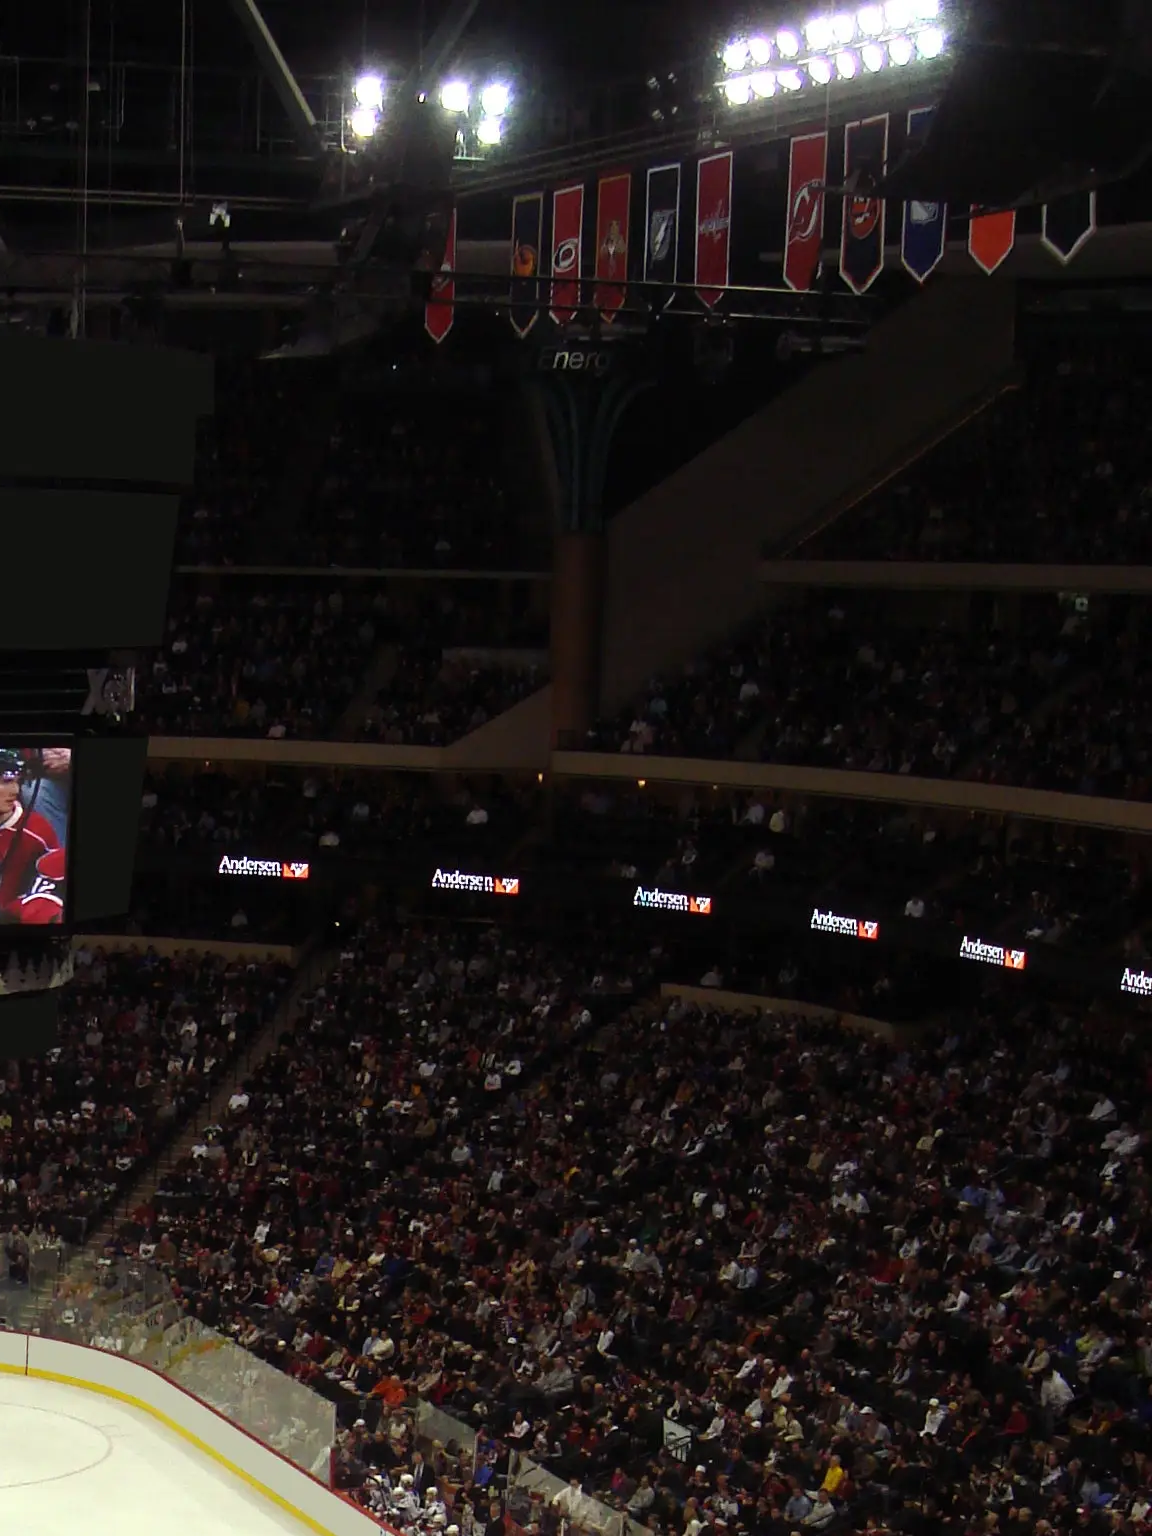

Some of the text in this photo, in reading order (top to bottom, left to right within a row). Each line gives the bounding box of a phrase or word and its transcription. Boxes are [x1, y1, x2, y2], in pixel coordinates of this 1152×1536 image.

[219, 855, 281, 872] Andersen
[432, 868, 494, 886] Andersen
[634, 886, 688, 906] Andersen
[811, 908, 858, 931] Andersen
[960, 936, 1004, 960] Andersen
